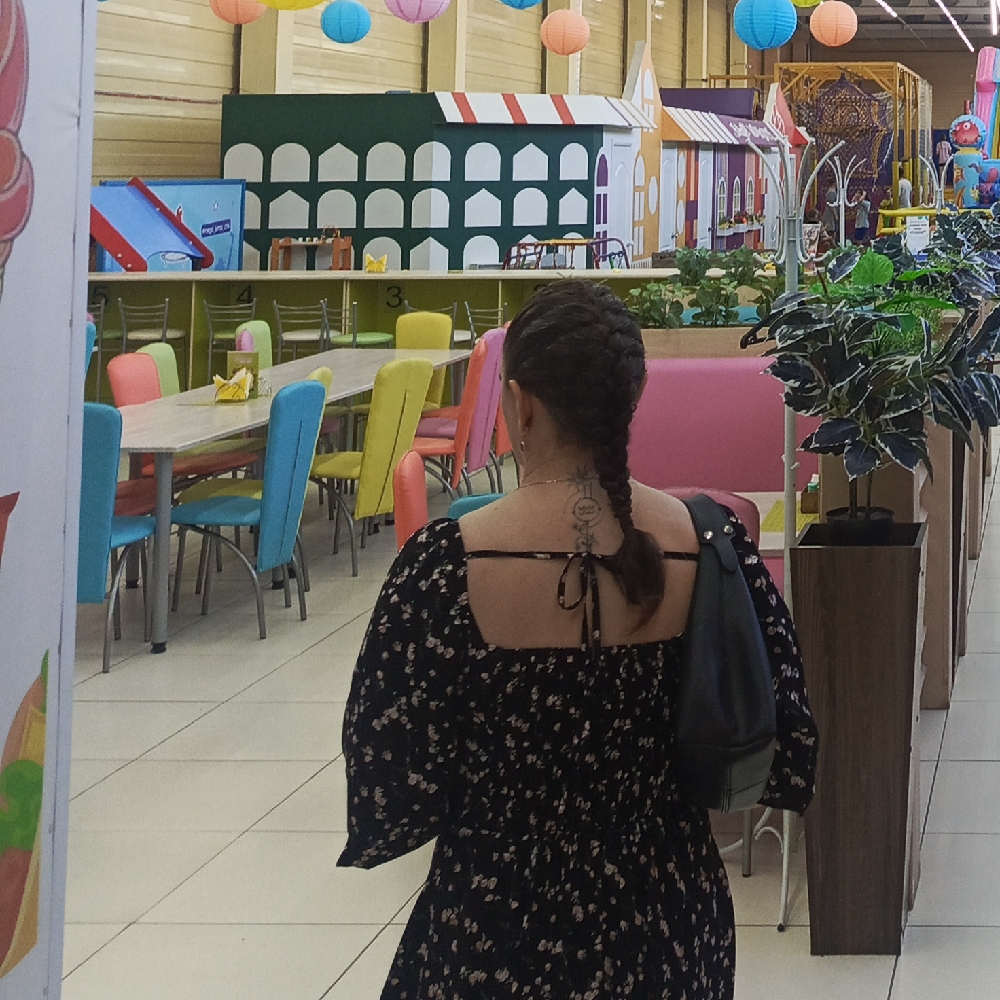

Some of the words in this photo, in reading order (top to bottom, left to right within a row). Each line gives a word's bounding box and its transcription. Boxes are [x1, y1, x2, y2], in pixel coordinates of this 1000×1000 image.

[92, 286, 109, 308] 5
[236, 284, 254, 304] 4
[386, 285, 402, 308] 3
